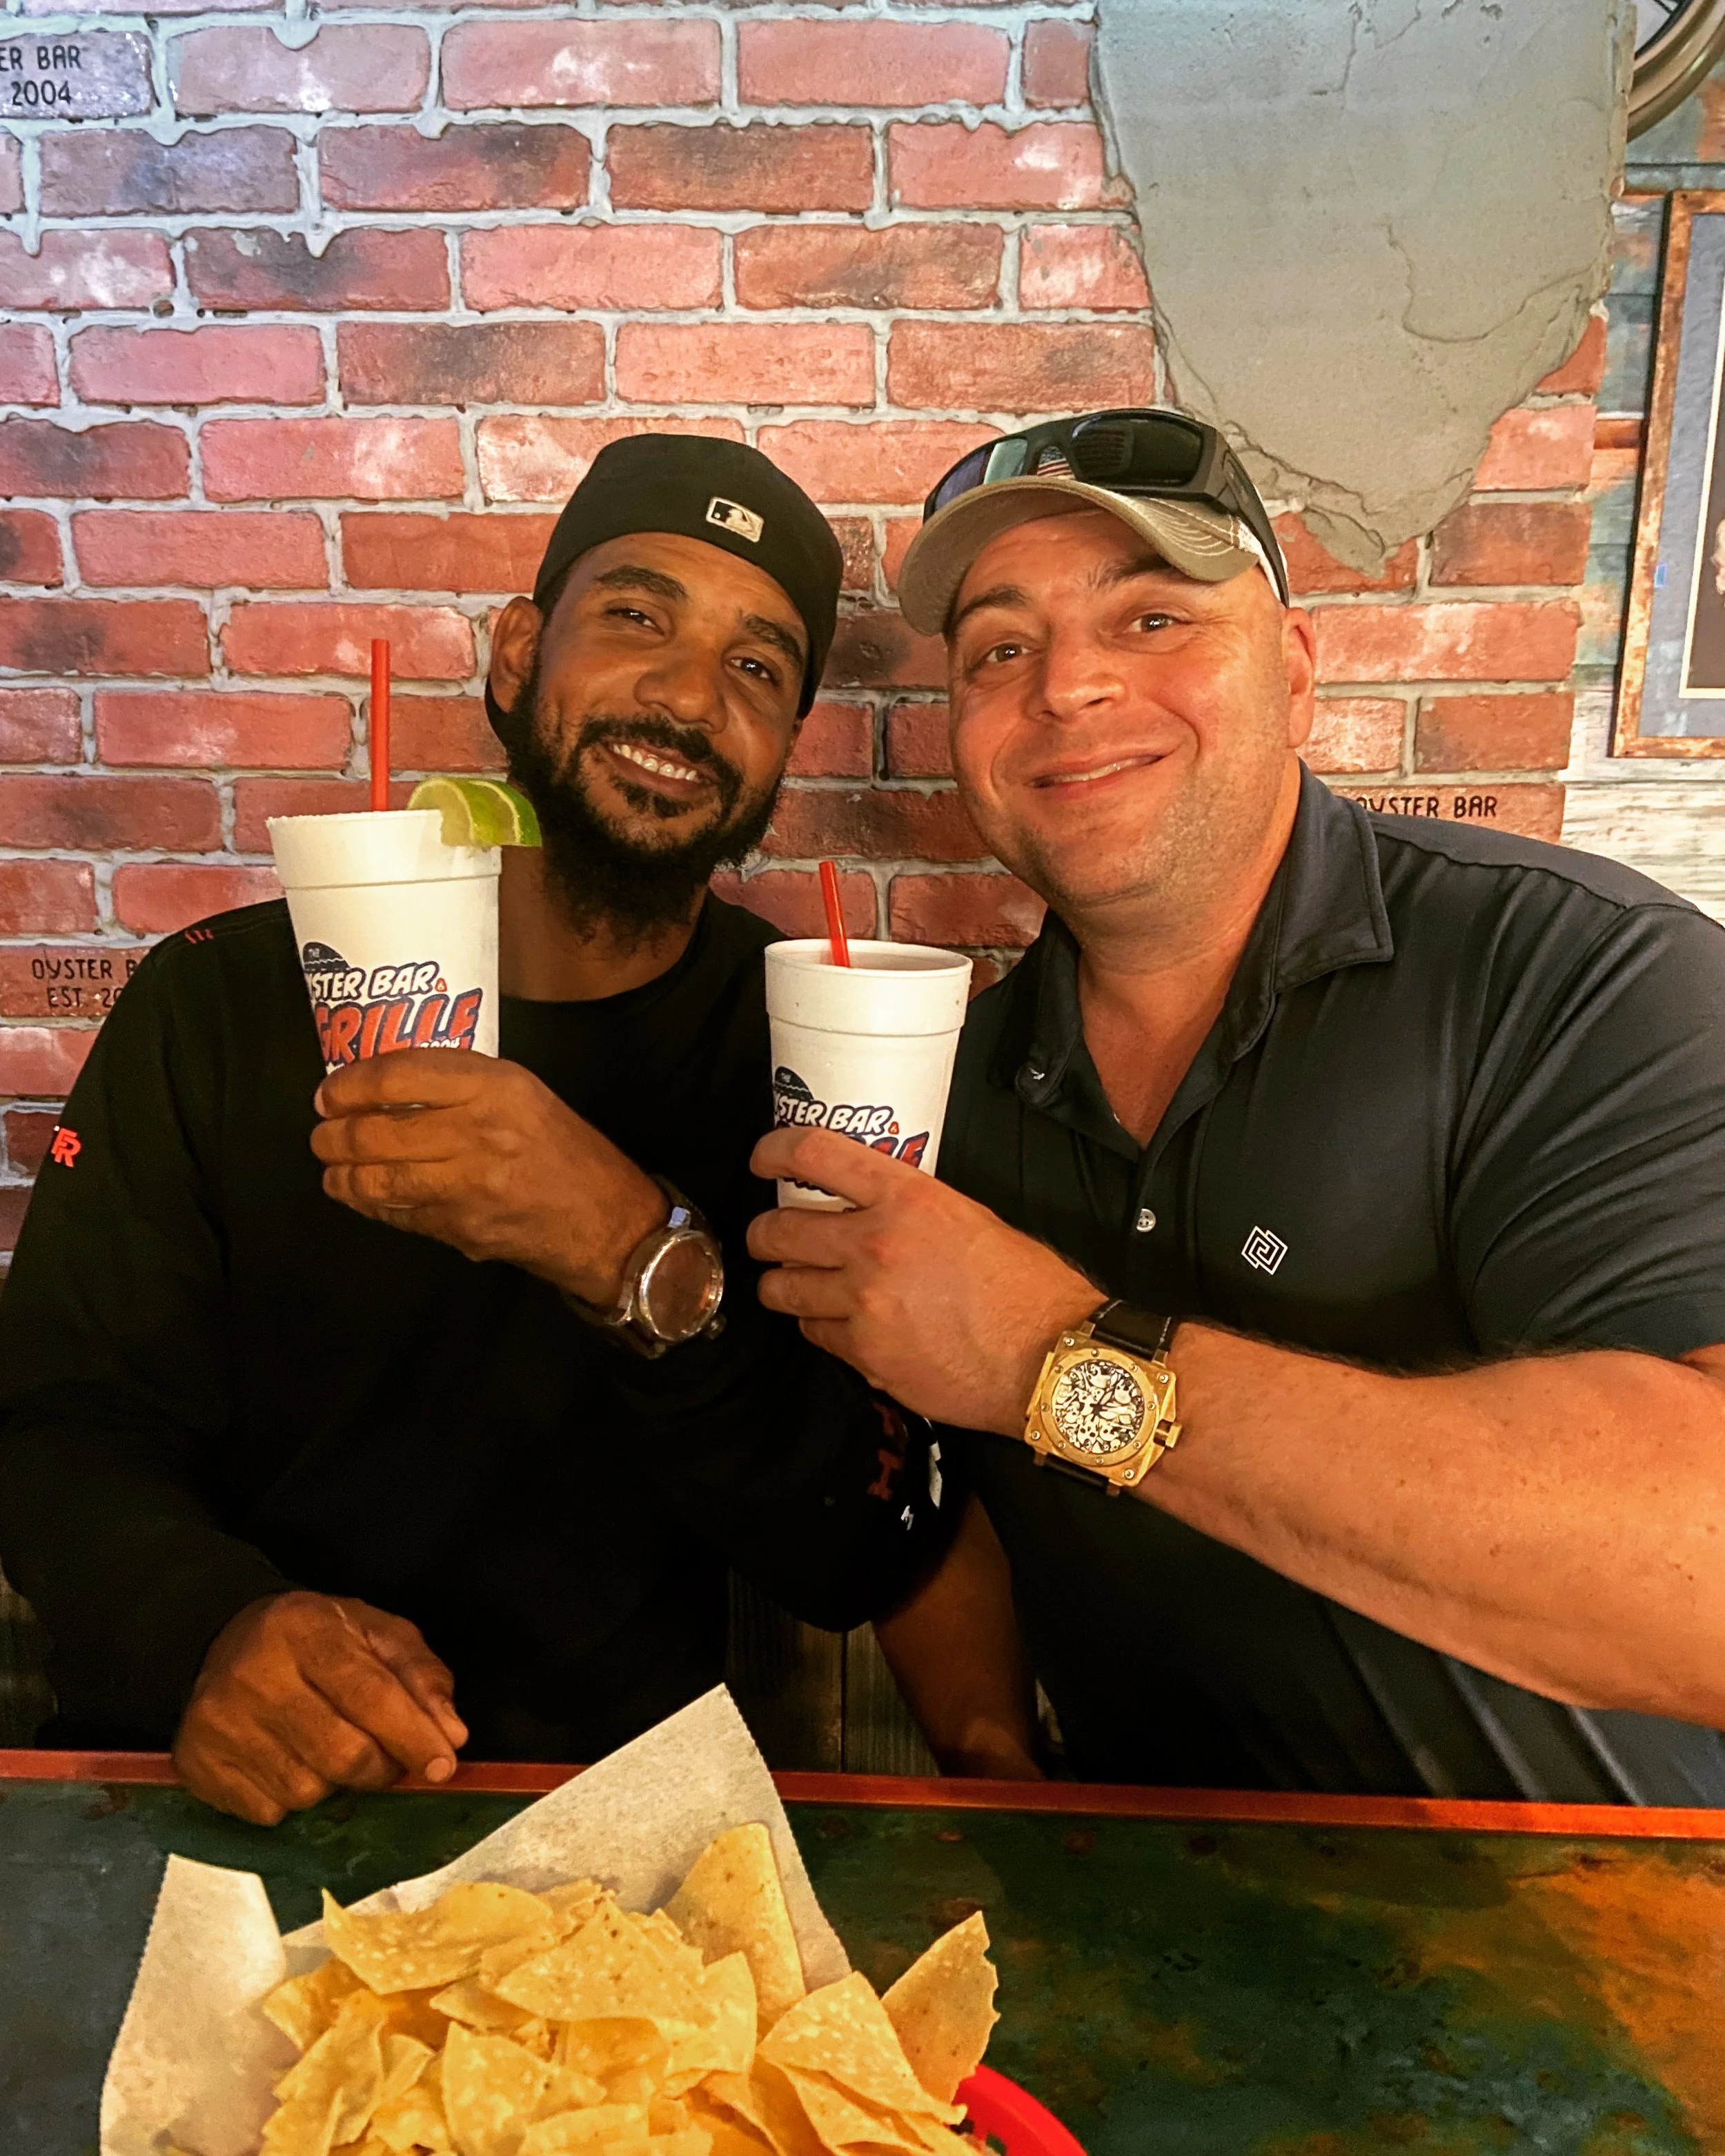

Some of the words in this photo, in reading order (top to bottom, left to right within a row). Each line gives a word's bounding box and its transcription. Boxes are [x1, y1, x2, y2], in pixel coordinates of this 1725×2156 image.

[37, 45, 82, 70] BAR
[11, 80, 72, 105] 2004
[1454, 795, 1497, 818] BAR
[32, 958, 112, 979] OYSTER
[370, 965, 436, 998] BAR
[47, 987, 82, 1008] EST
[829, 1108, 890, 1134] BAR
